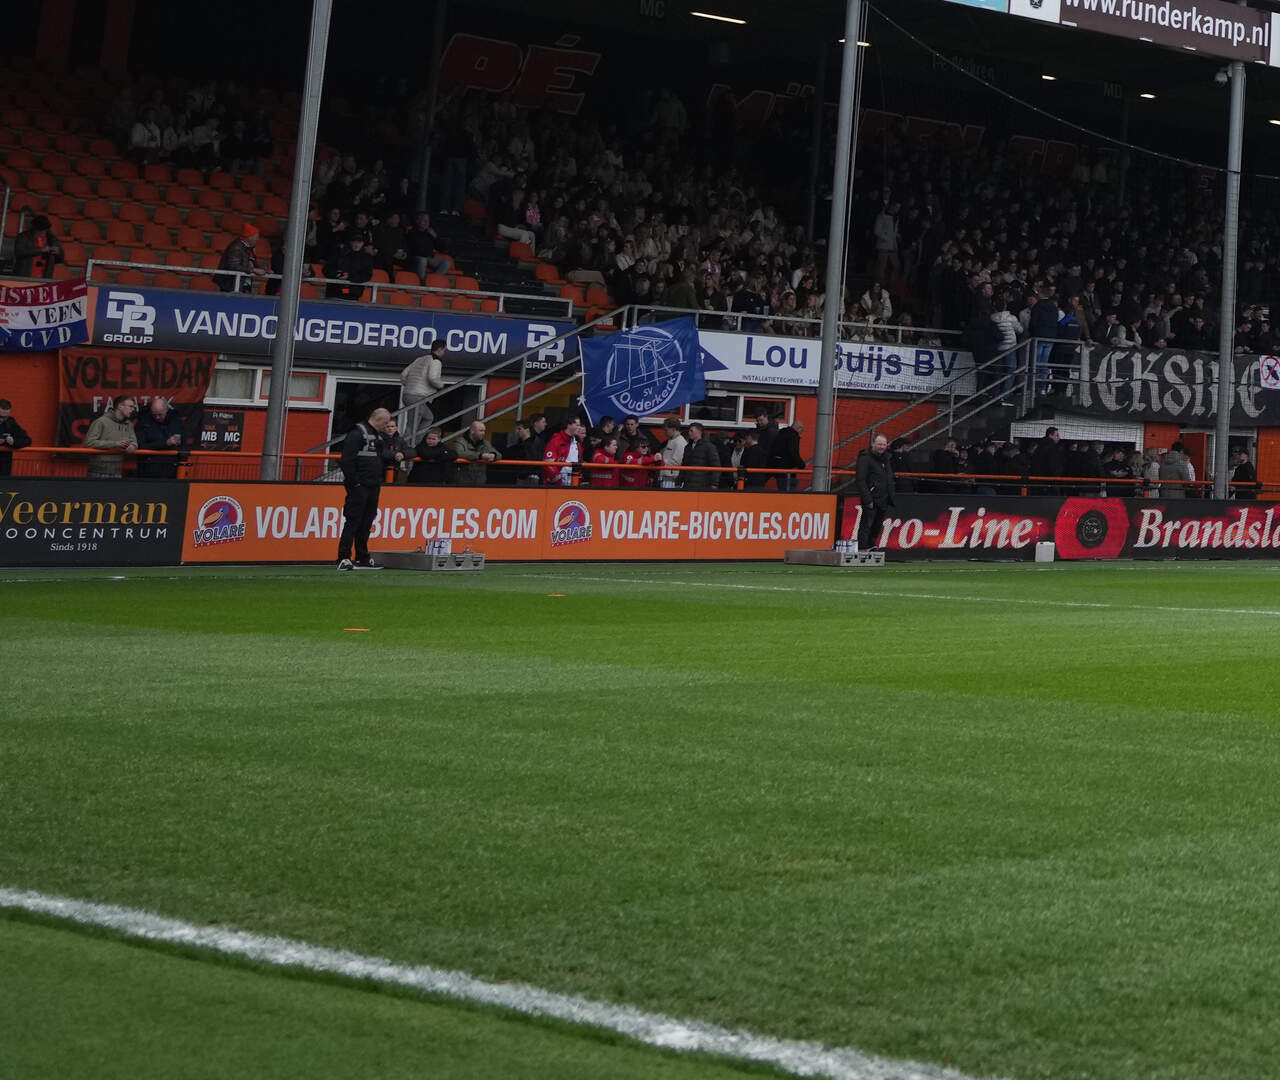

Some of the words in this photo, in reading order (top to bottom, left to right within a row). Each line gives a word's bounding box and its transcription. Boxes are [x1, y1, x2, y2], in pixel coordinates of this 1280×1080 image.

[28, 301, 83, 326] VEEN
[104, 333, 153, 344] GROUP
[745, 337, 808, 369] Lou
[914, 349, 959, 378] BV
[619, 376, 677, 412] Ouderkerk
[201, 431, 217, 442] MB
[223, 431, 240, 442] MC
[193, 523, 246, 544] VOLARE
[550, 526, 593, 543] VOLARE
[599, 509, 831, 542] VOLARE-BICYCLES.COM
[50, 542, 75, 552] Sinds
[76, 542, 98, 552] 1918
